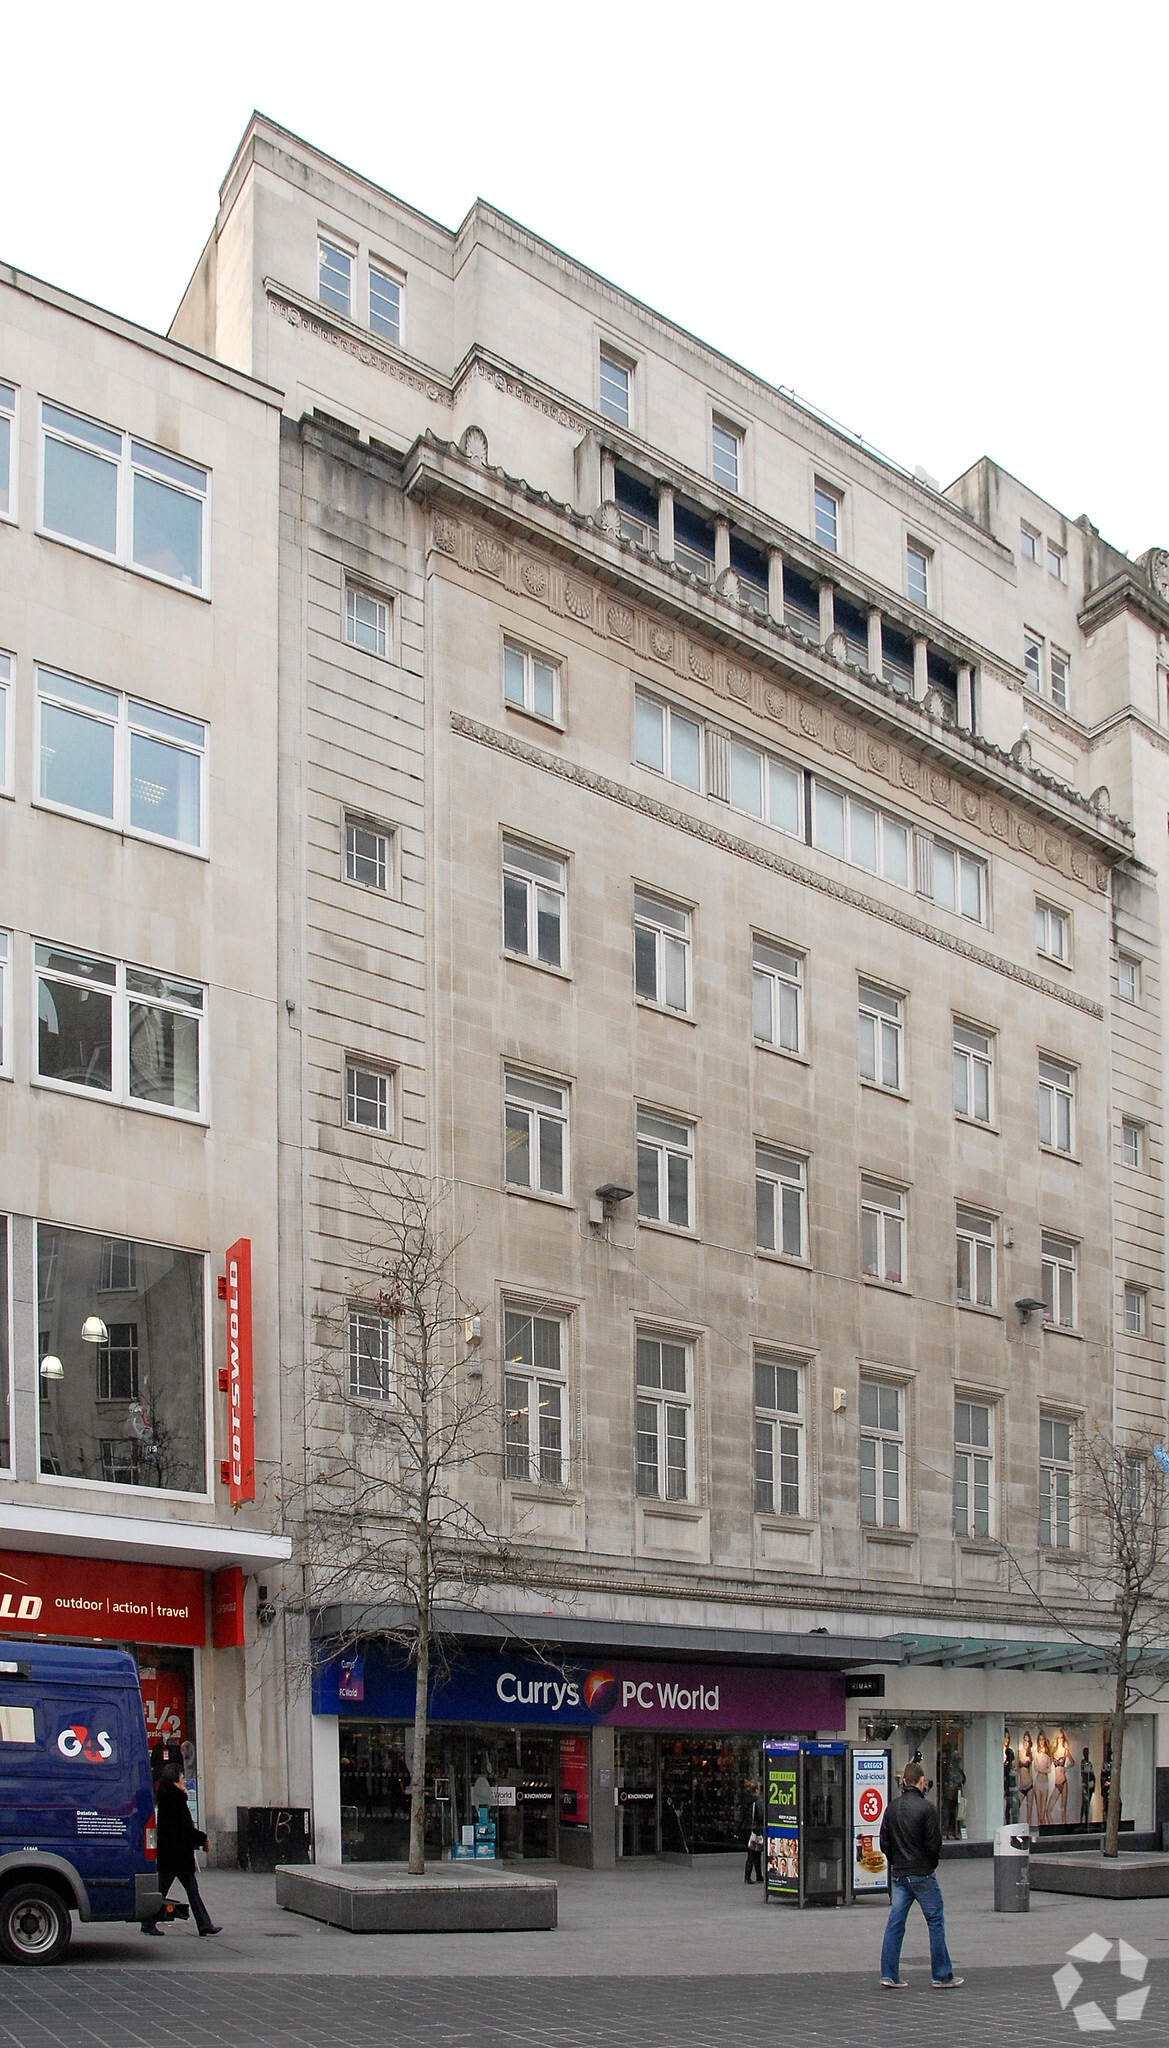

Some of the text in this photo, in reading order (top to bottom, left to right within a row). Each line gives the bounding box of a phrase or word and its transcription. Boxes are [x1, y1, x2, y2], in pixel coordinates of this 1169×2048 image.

[229, 1260, 241, 1486] COTSWOLD
[55, 1597, 103, 1610] outdoor
[113, 1602, 148, 1614] action
[157, 1605, 188, 1618] travel
[496, 1673, 719, 1711] Currys PC World
[57, 1725, 112, 1762] G4S
[863, 1797, 878, 1815] £3
